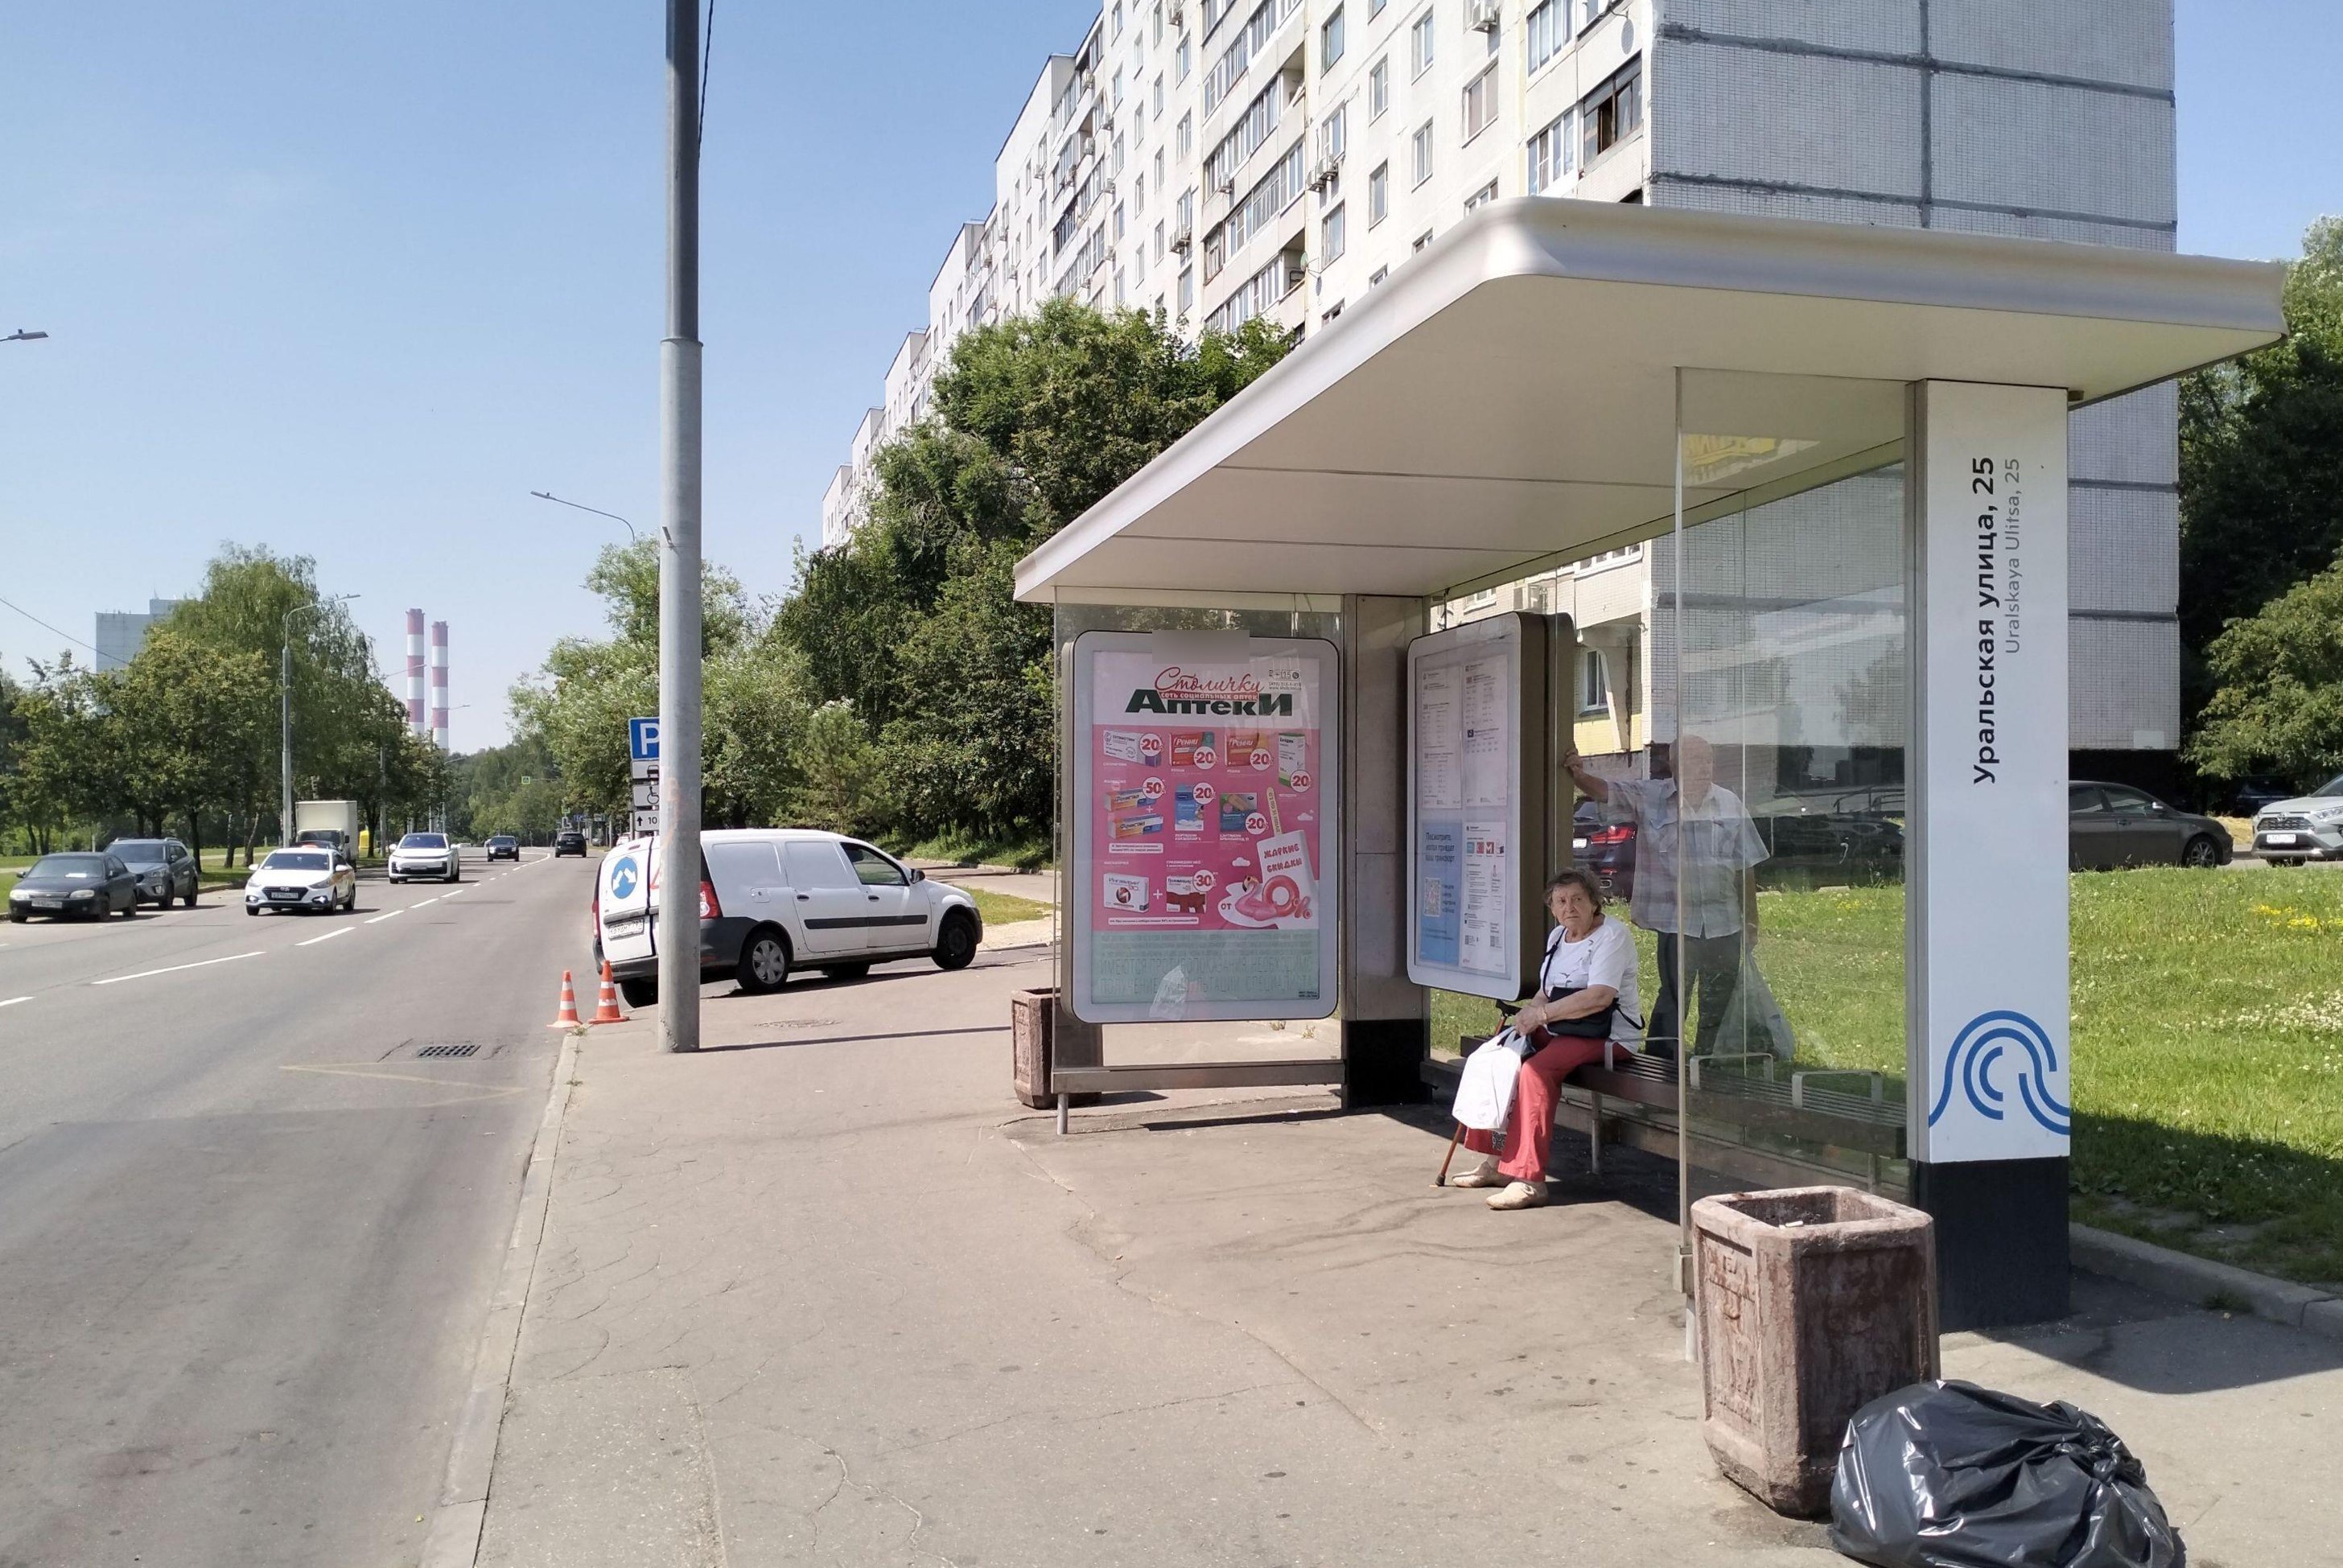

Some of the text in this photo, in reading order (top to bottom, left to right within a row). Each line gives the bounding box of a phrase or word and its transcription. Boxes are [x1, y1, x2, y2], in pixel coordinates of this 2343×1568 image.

[2004, 459, 2023, 653] Uralskaya Ulitsa, 25
[1972, 458, 2000, 784] Уральская улица, 25
[1155, 666, 1265, 692] Столички
[1180, 692, 1232, 700] социальных
[640, 722, 659, 755] P
[648, 817, 657, 825] 10
